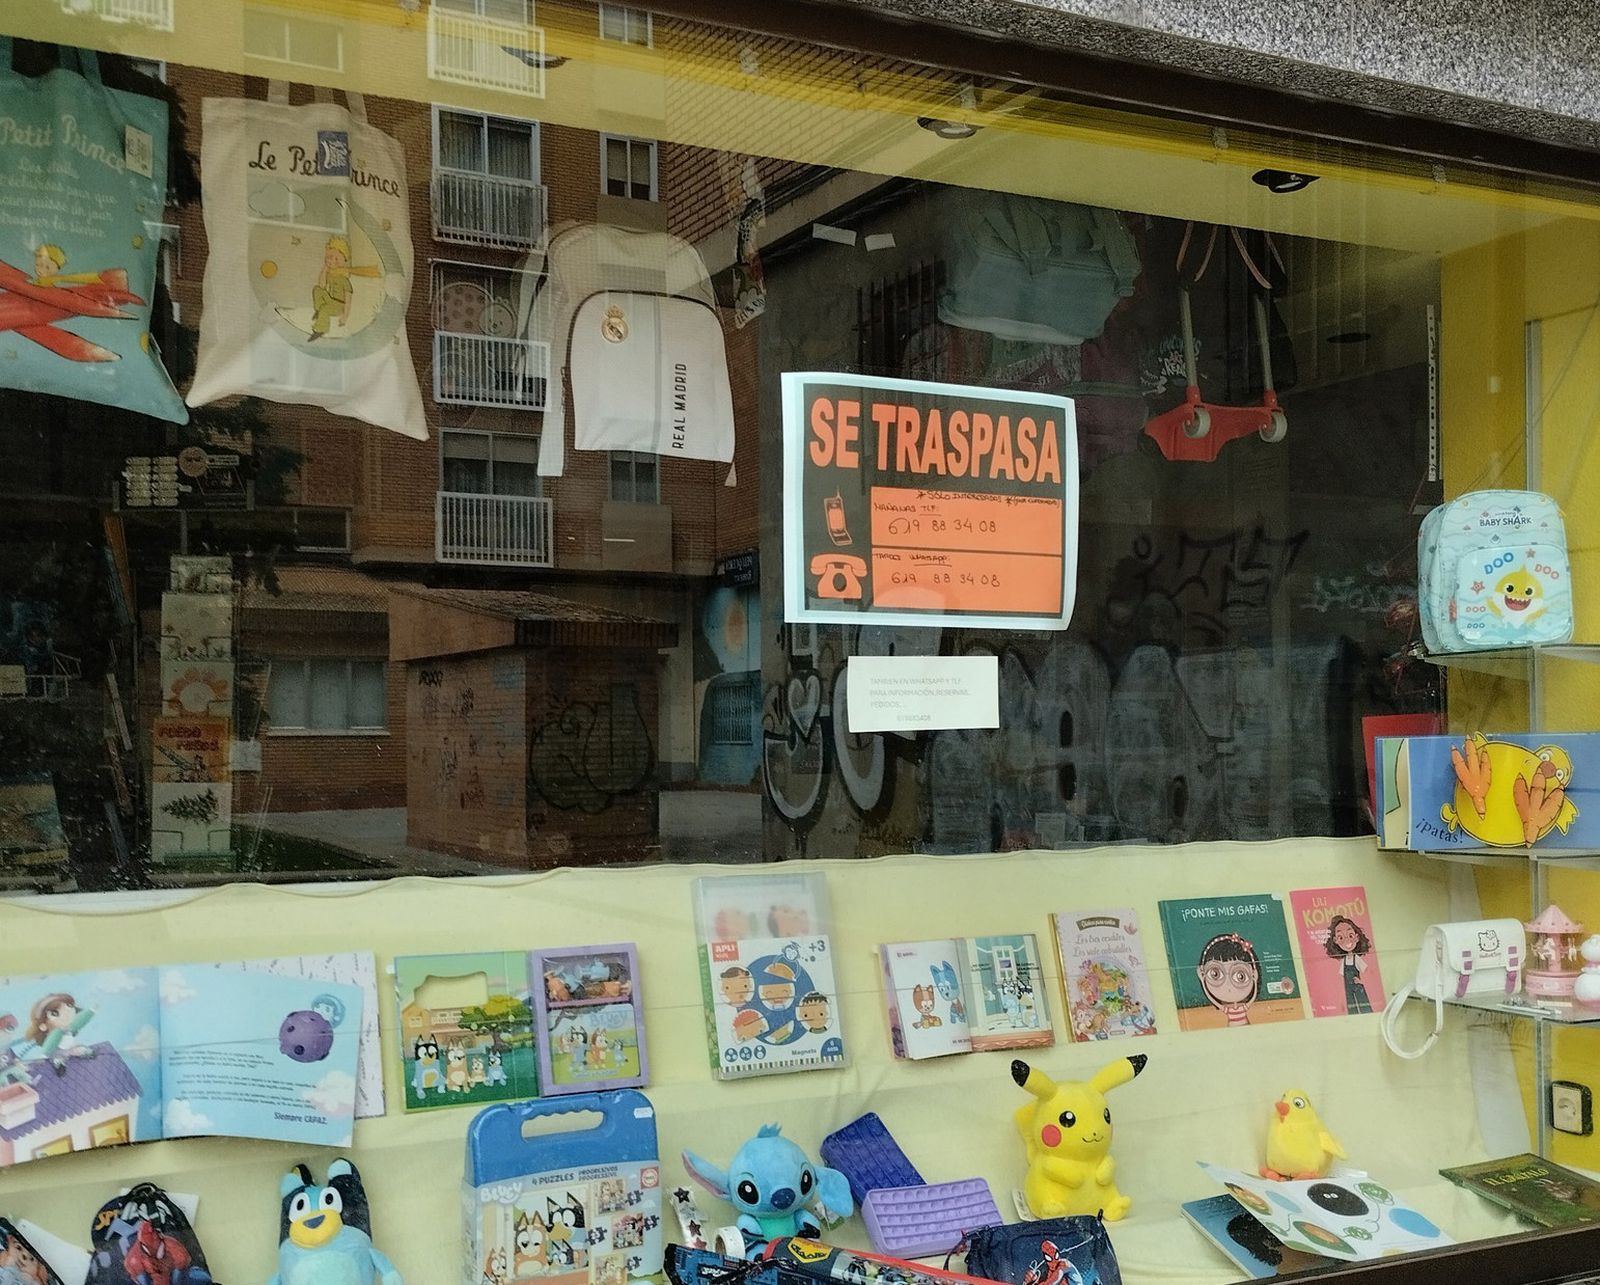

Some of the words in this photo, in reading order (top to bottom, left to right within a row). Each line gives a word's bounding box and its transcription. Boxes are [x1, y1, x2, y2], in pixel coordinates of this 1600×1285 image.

[248, 140, 278, 170] Le
[350, 167, 401, 198] rince
[673, 362, 687, 411] MADRID
[672, 417, 686, 450] REAL
[809, 397, 861, 469] SE
[871, 403, 1062, 484] TRASPASA
[888, 517, 921, 535] 619
[931, 519, 947, 532] 88
[953, 518, 973, 534] 34
[979, 519, 997, 533] 08
[1479, 518, 1501, 527] BABY
[1502, 515, 1532, 526] SHARK
[1484, 552, 1514, 575] DOO
[1534, 563, 1560, 580] DOO
[891, 571, 918, 585] 619
[933, 571, 951, 584] 88
[960, 572, 975, 586] 34
[980, 573, 1001, 588] 08
[1465, 605, 1487, 613] DOO
[1181, 906, 1216, 922] ¡PONTE
[1218, 905, 1235, 917] MIS
[1237, 903, 1269, 916] GAFAS!
[714, 944, 736, 953] APLI
[809, 940, 826, 952] +3
[538, 1172, 575, 1185] PUZZLES
